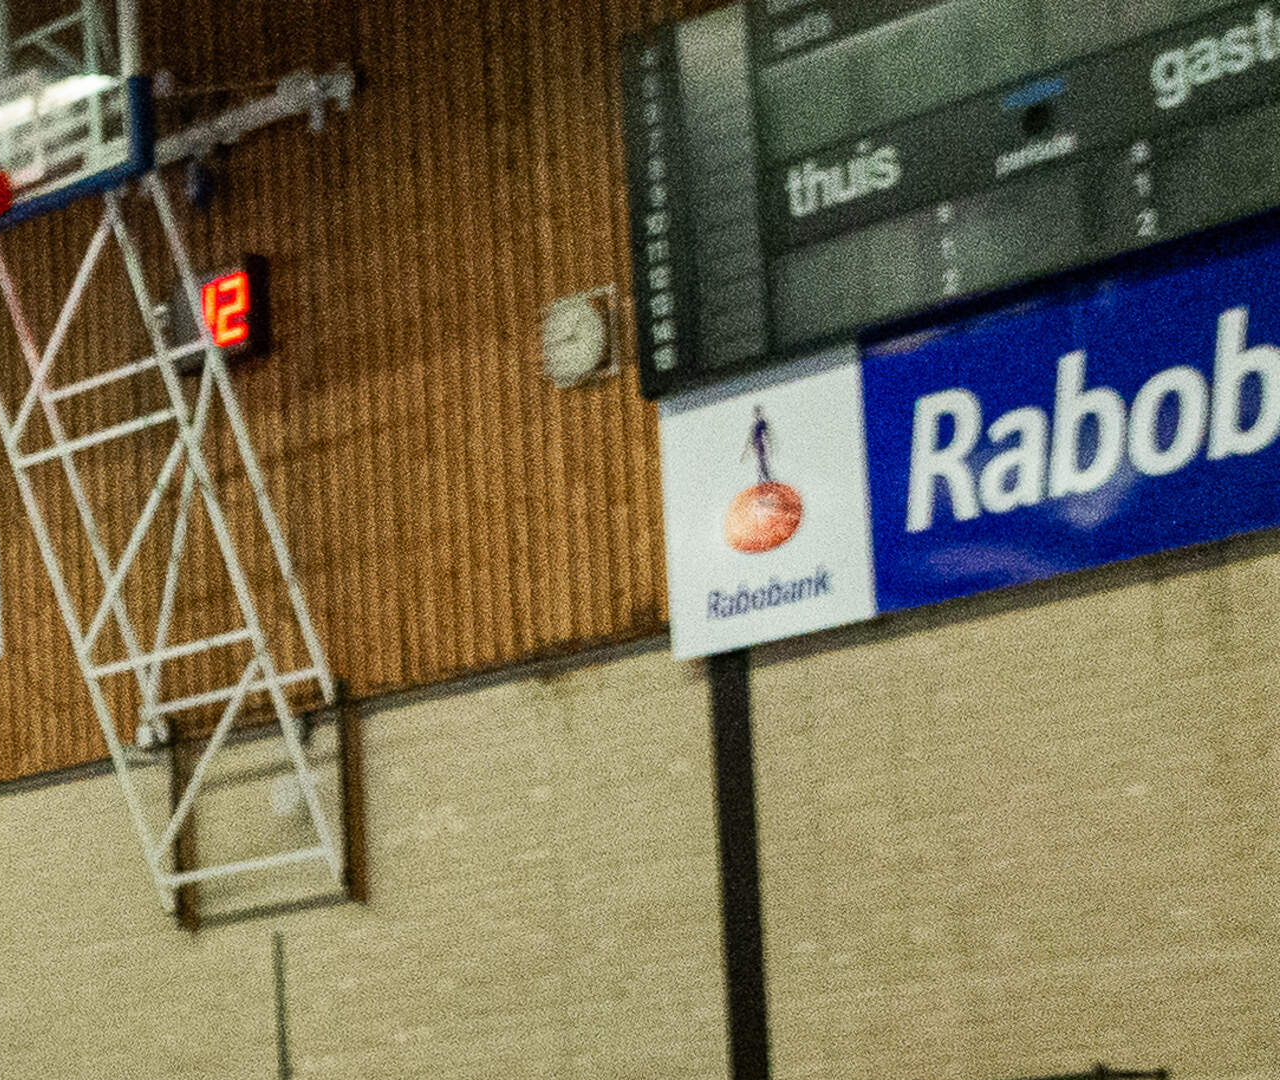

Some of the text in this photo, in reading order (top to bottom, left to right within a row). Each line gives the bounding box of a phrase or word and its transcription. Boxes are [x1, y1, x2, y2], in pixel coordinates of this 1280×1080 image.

[1151, 5, 1280, 108] gast
[785, 139, 901, 217] thuis
[706, 566, 832, 622] Rabobank
